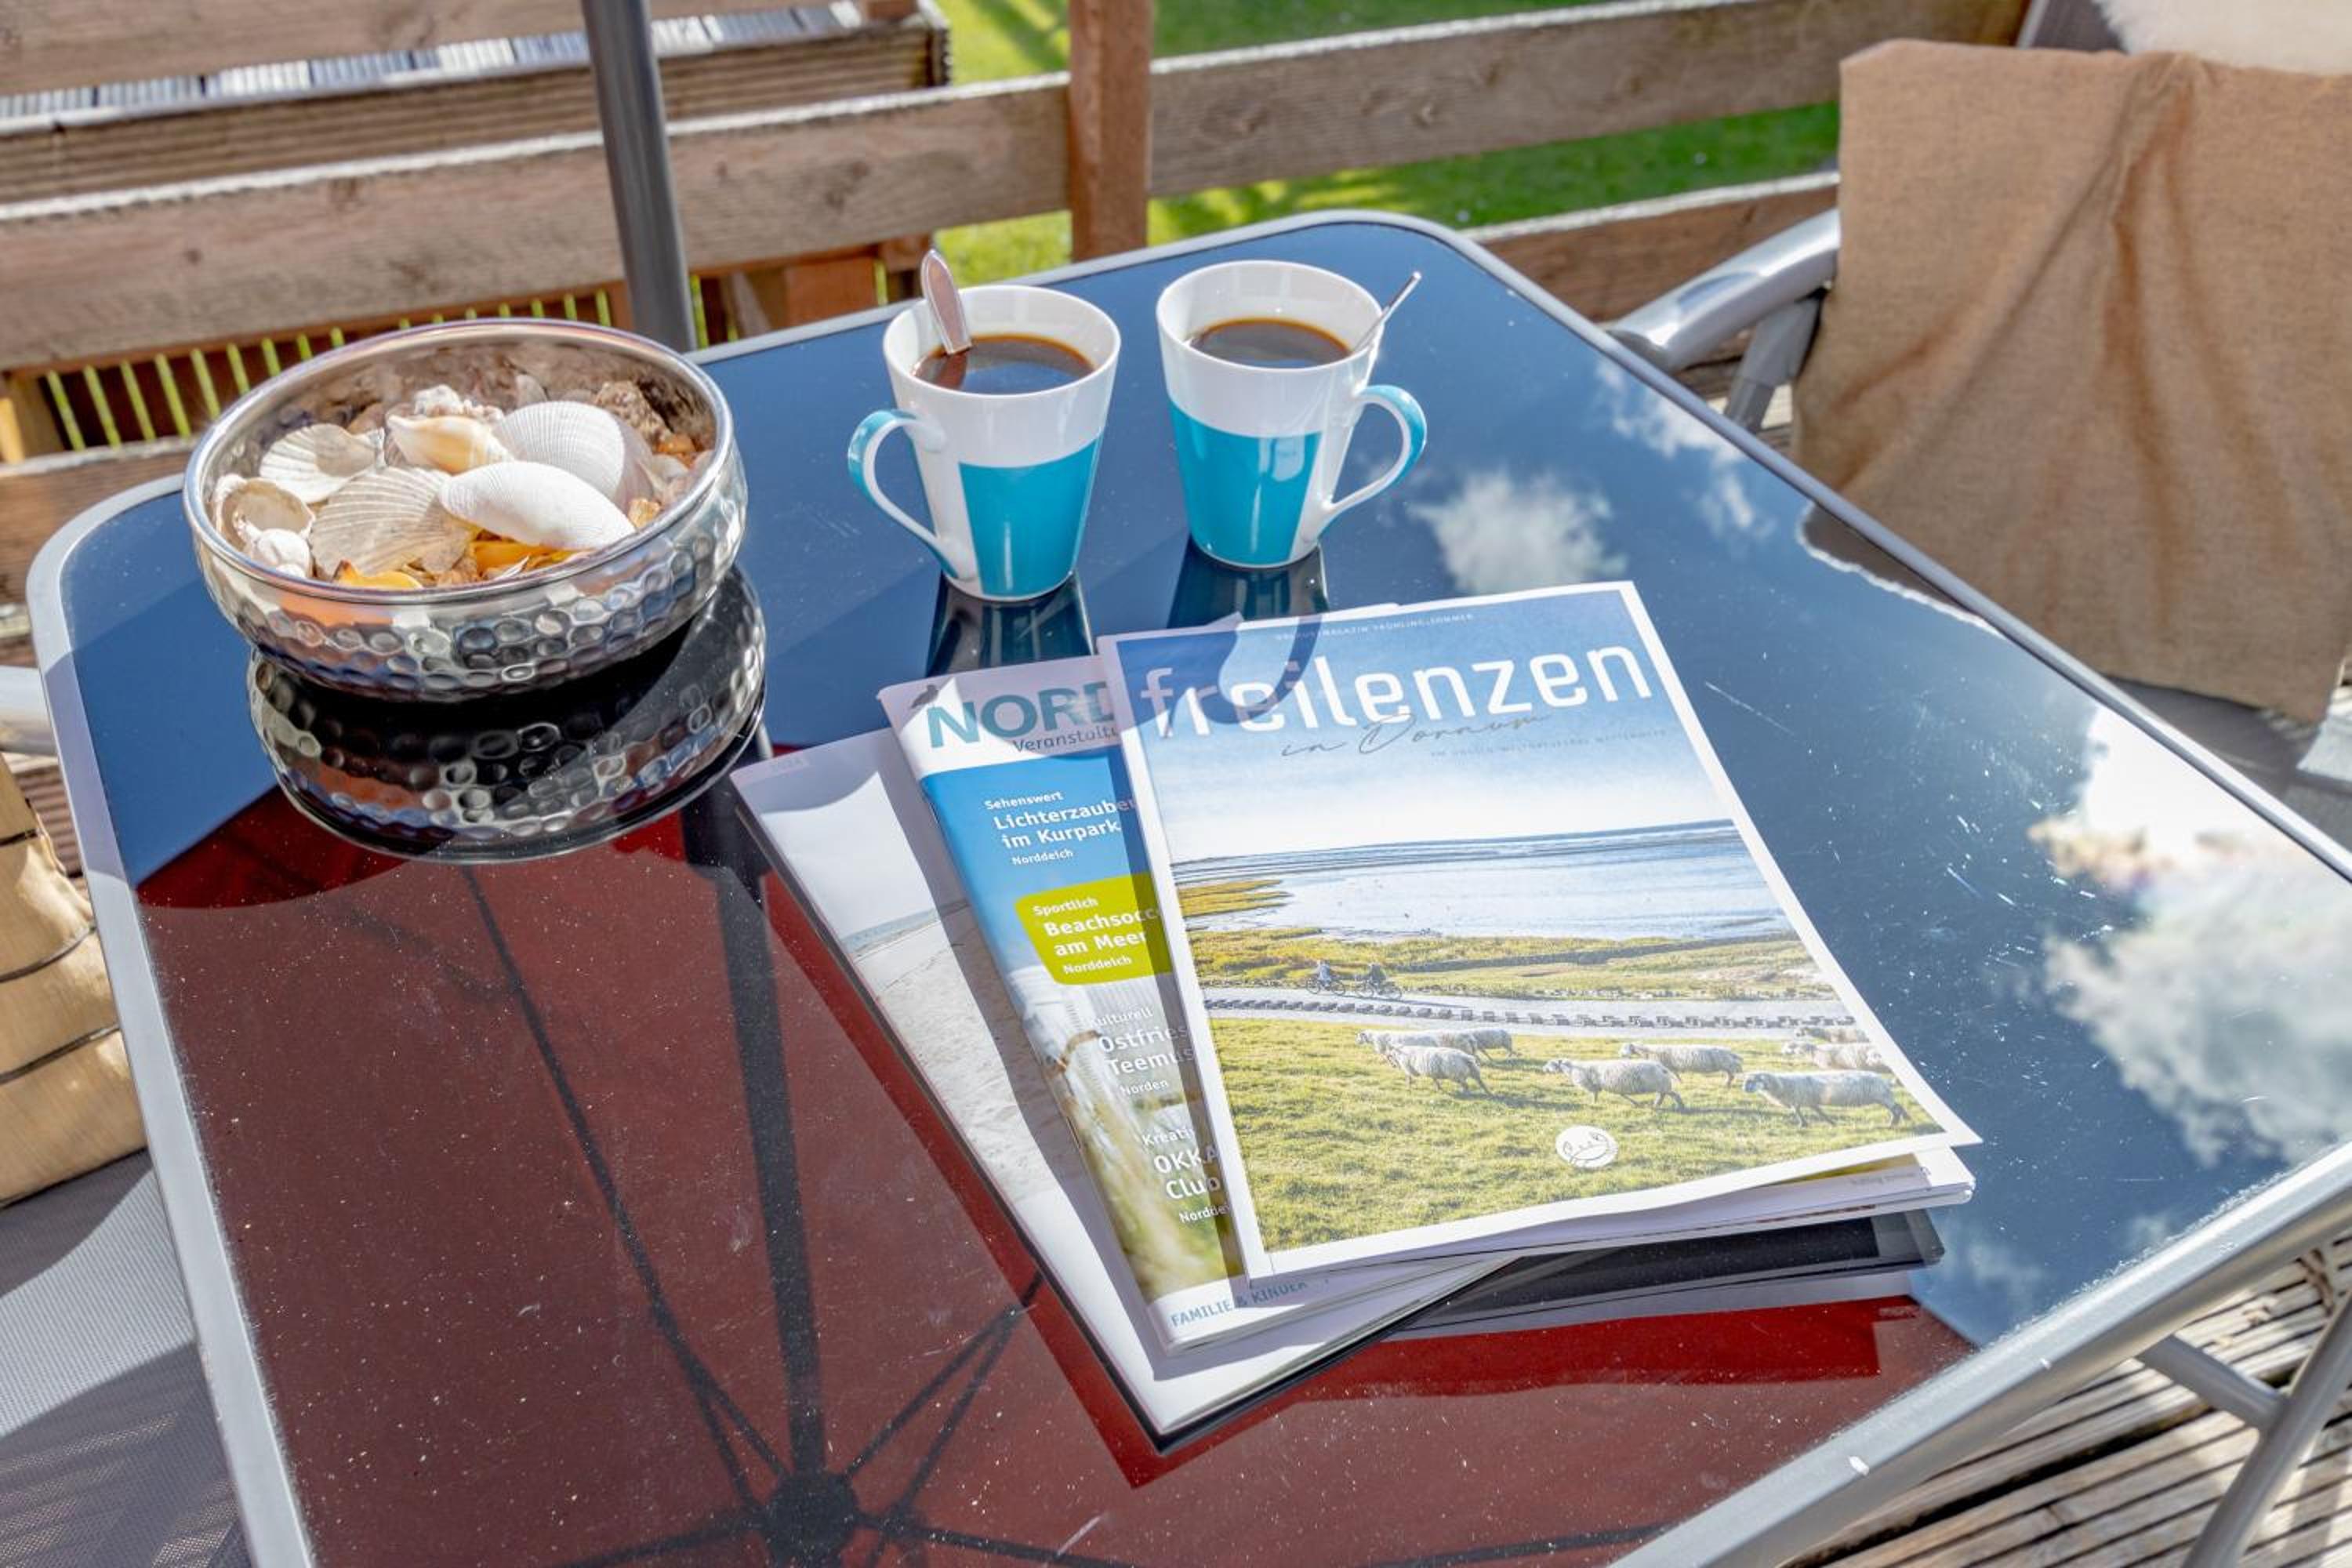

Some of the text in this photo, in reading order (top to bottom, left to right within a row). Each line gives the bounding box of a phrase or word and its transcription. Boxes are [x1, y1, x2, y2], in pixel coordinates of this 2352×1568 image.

[1140, 644, 1652, 739] freilenzen
[984, 791, 1065, 810] Sehenswert
[1001, 819, 1122, 849] im Kurpark
[1011, 848, 1073, 866] Norddeich
[1033, 896, 1099, 916] Sportlich
[1054, 931, 1147, 956] am Meer
[1062, 954, 1132, 975] Norddeich
[1120, 1080, 1169, 1097] Norden
[1171, 1299, 1234, 1327] FAMILIE
